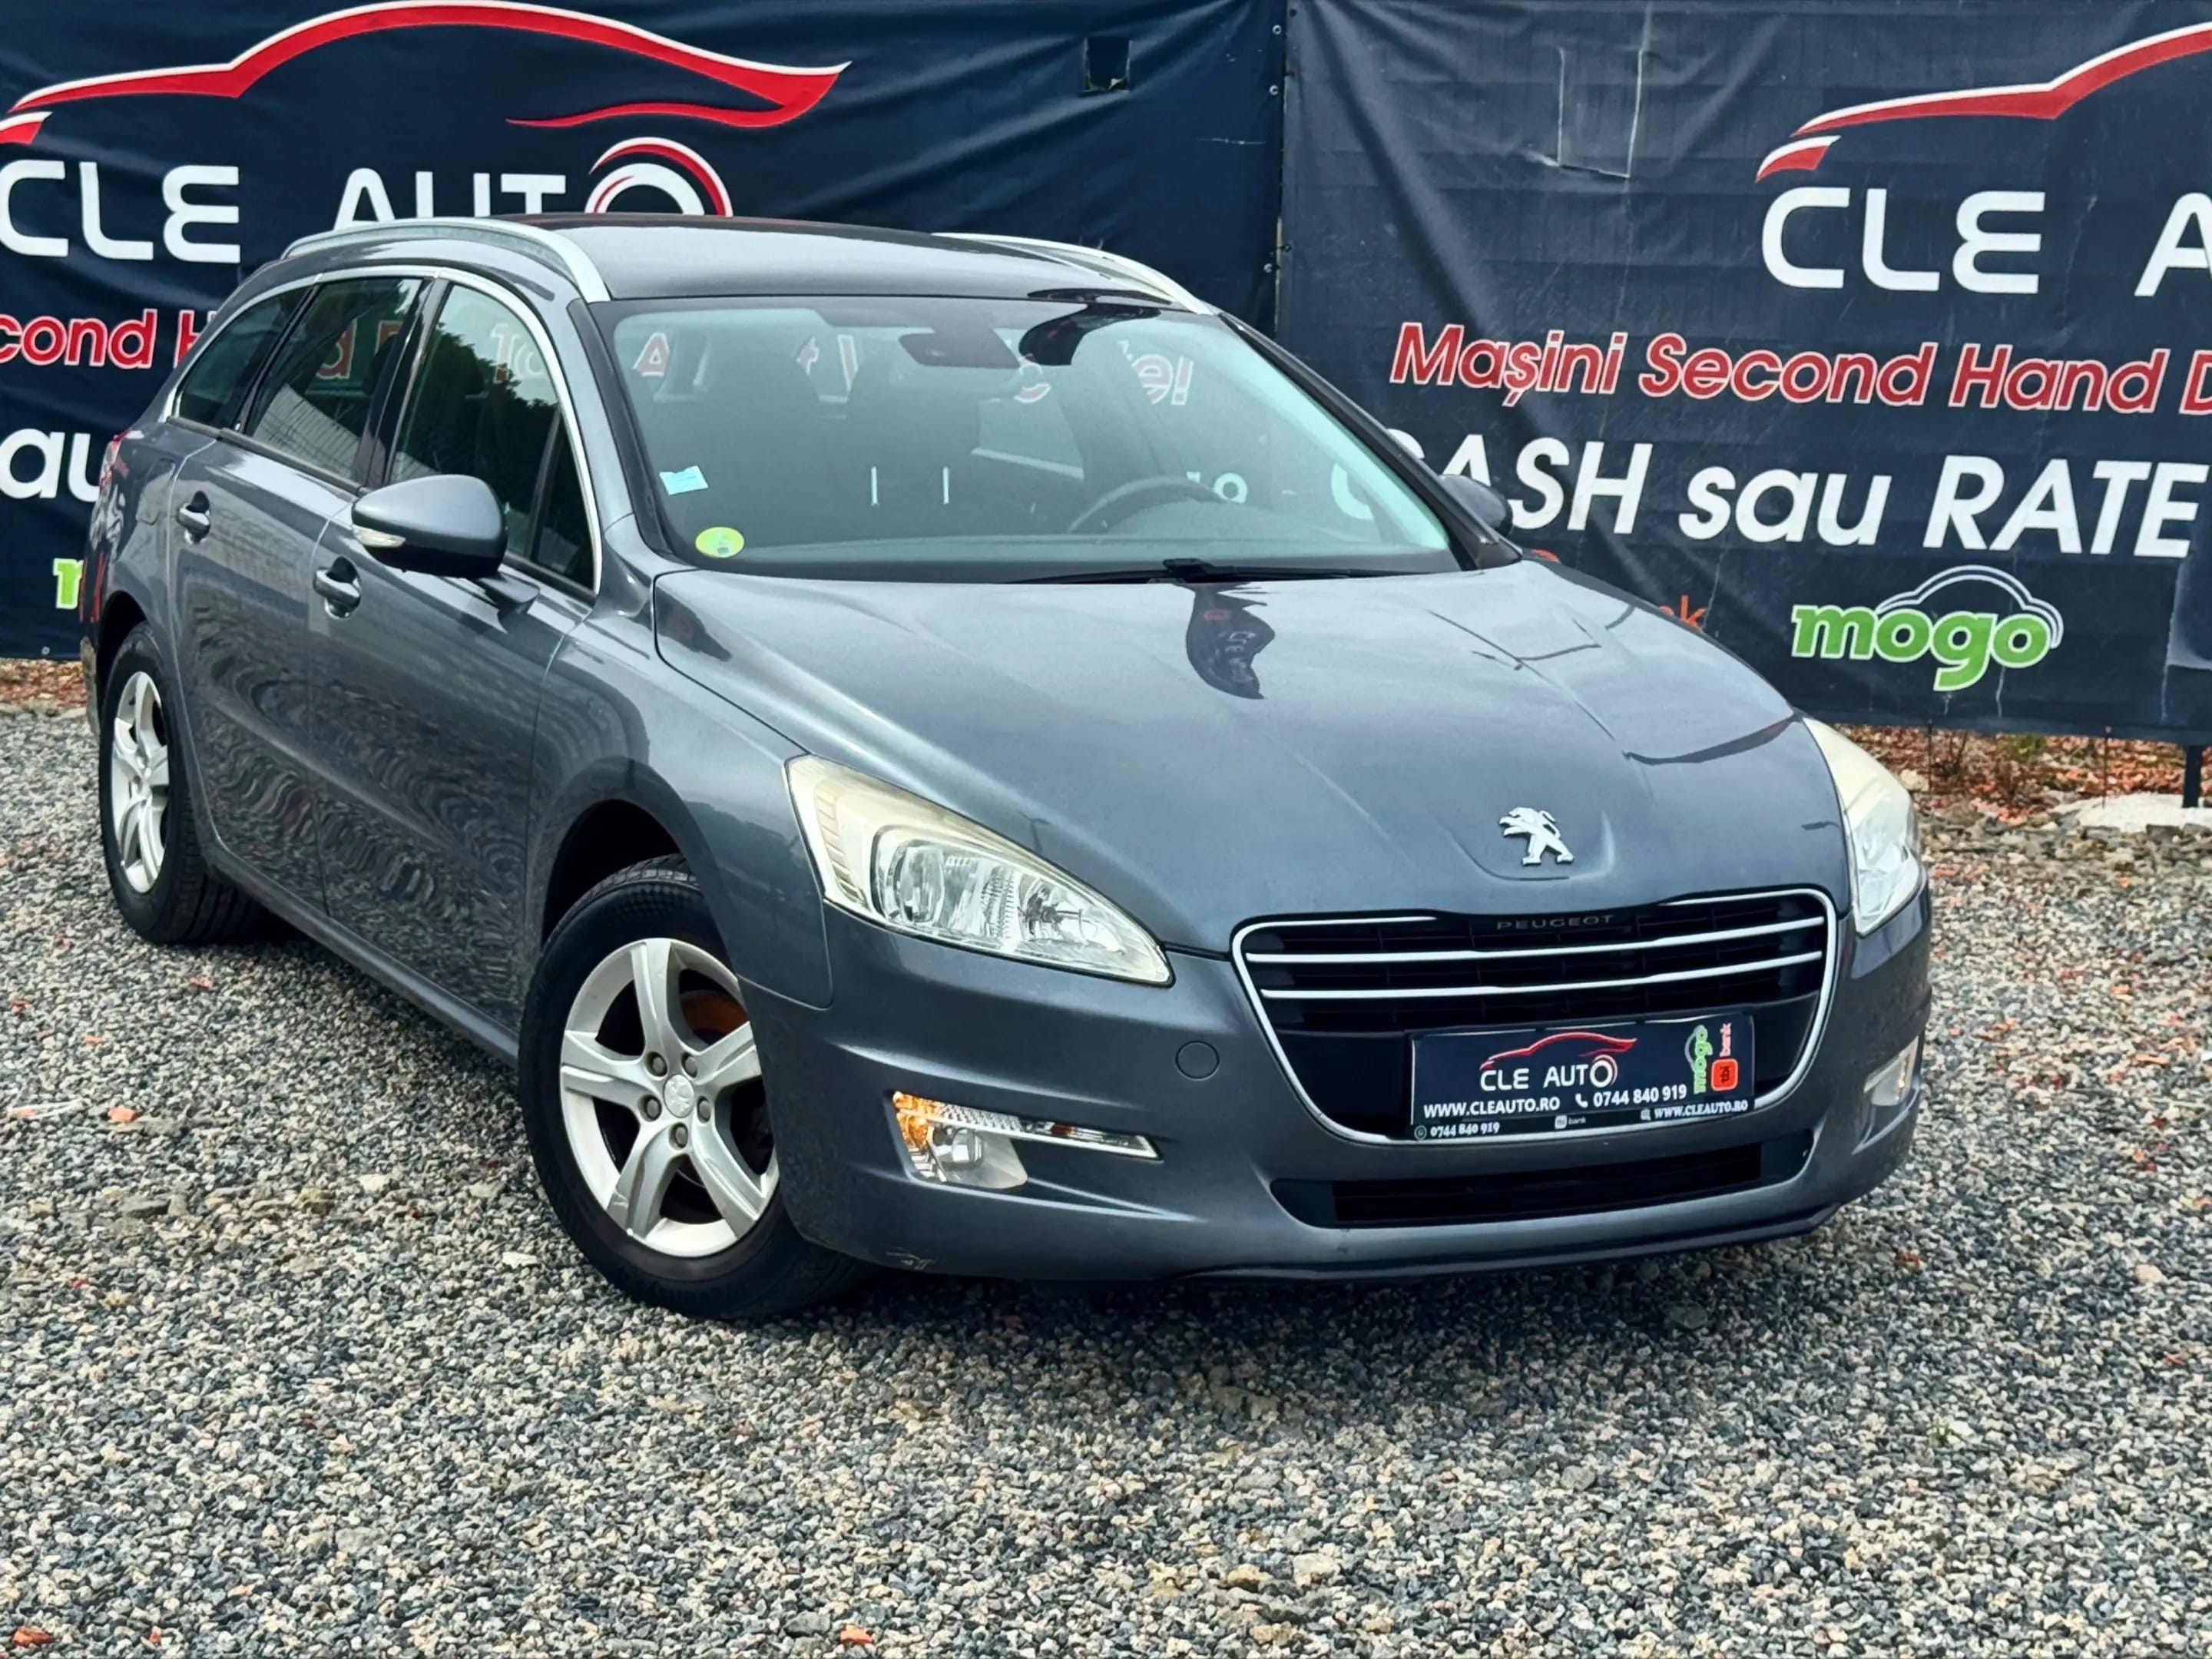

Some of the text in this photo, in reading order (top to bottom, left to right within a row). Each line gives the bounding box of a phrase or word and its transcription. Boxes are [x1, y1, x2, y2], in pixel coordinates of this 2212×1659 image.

[0, 159, 240, 263] CLE
[1760, 186, 2045, 295] CLE
[1389, 321, 1628, 408] Mașini
[1638, 332, 1939, 406] Second
[1948, 343, 2171, 415] Hand
[1678, 465, 1892, 547] sau
[1922, 454, 2210, 558] RATE
[1790, 602, 2052, 691] mogo
[1497, 915, 1614, 930] PEUGEOT
[1480, 1058, 1614, 1091] CLE AUTO
[1423, 1096, 1561, 1119] WWW.CLEAUTO.RO
[1593, 1084, 1687, 1108] 0744 840 919
[1654, 1099, 1748, 1118] WWW.CLEAUTO.RO
[1429, 1122, 1500, 1137] 0744 840 919
